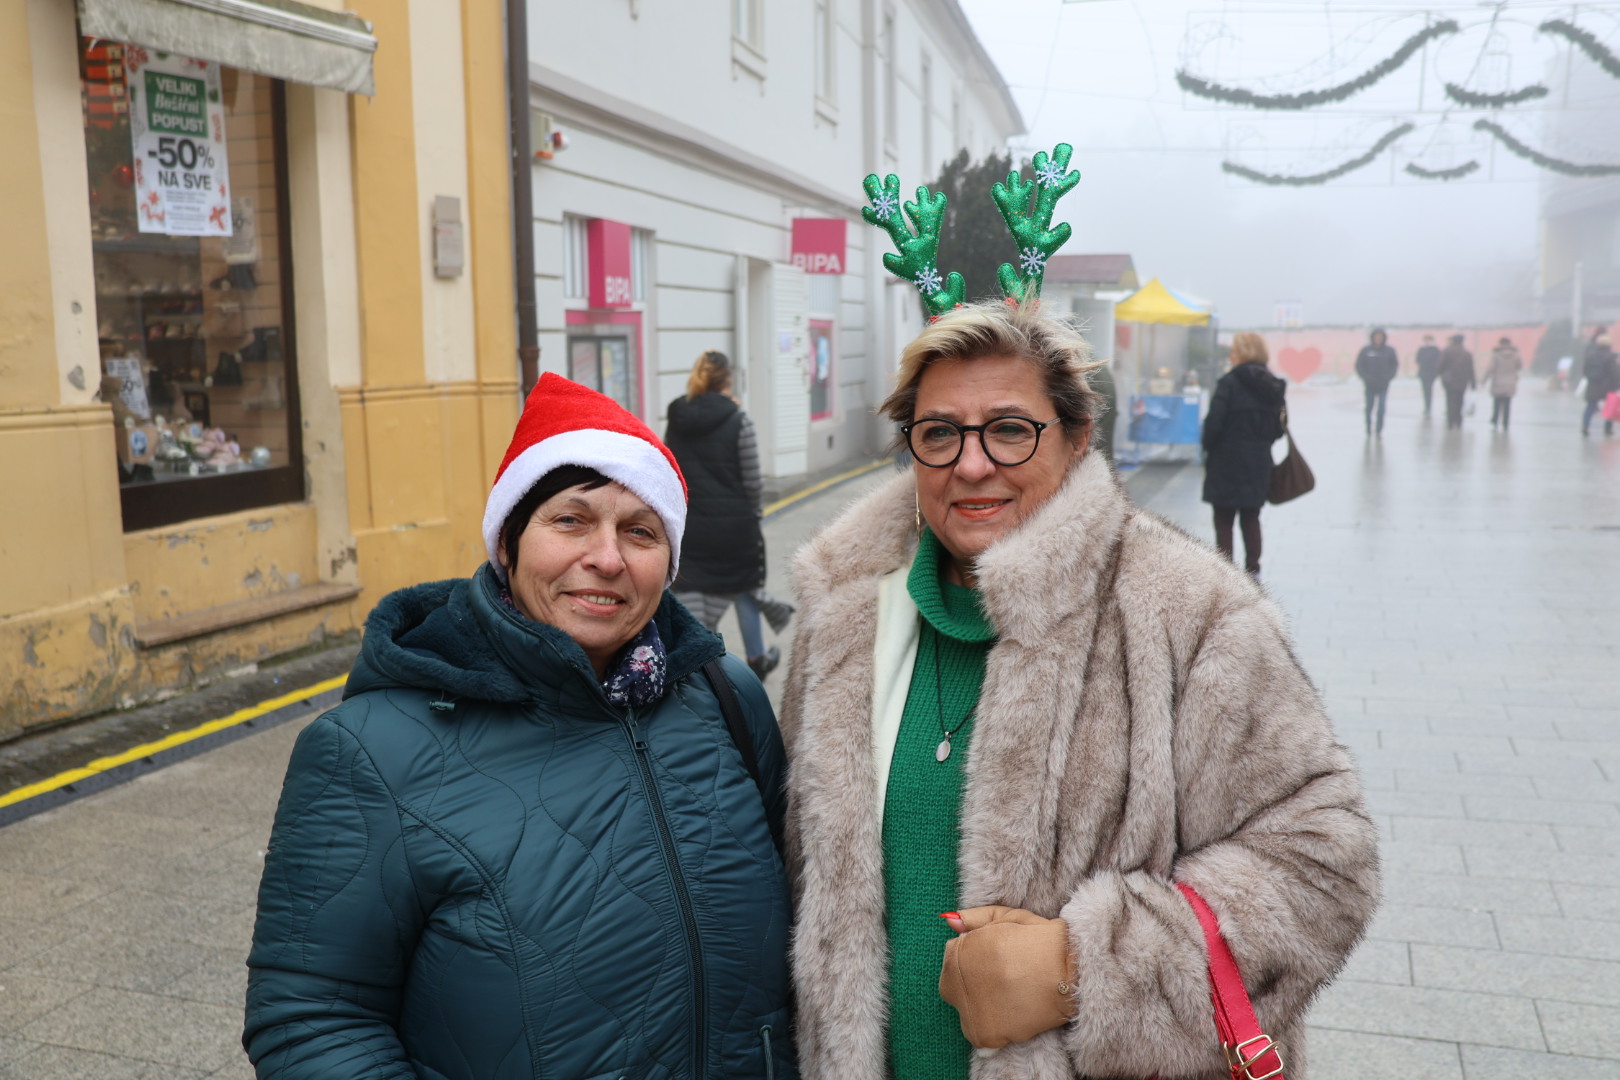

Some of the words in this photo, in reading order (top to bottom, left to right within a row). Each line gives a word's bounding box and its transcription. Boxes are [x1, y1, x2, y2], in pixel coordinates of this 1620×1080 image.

[156, 78, 197, 96] VELIKI
[152, 112, 204, 131] POPUST
[148, 136, 215, 170] -50%
[158, 171, 179, 187] NA
[183, 173, 212, 190] SVE
[605, 277, 630, 303] BIPA
